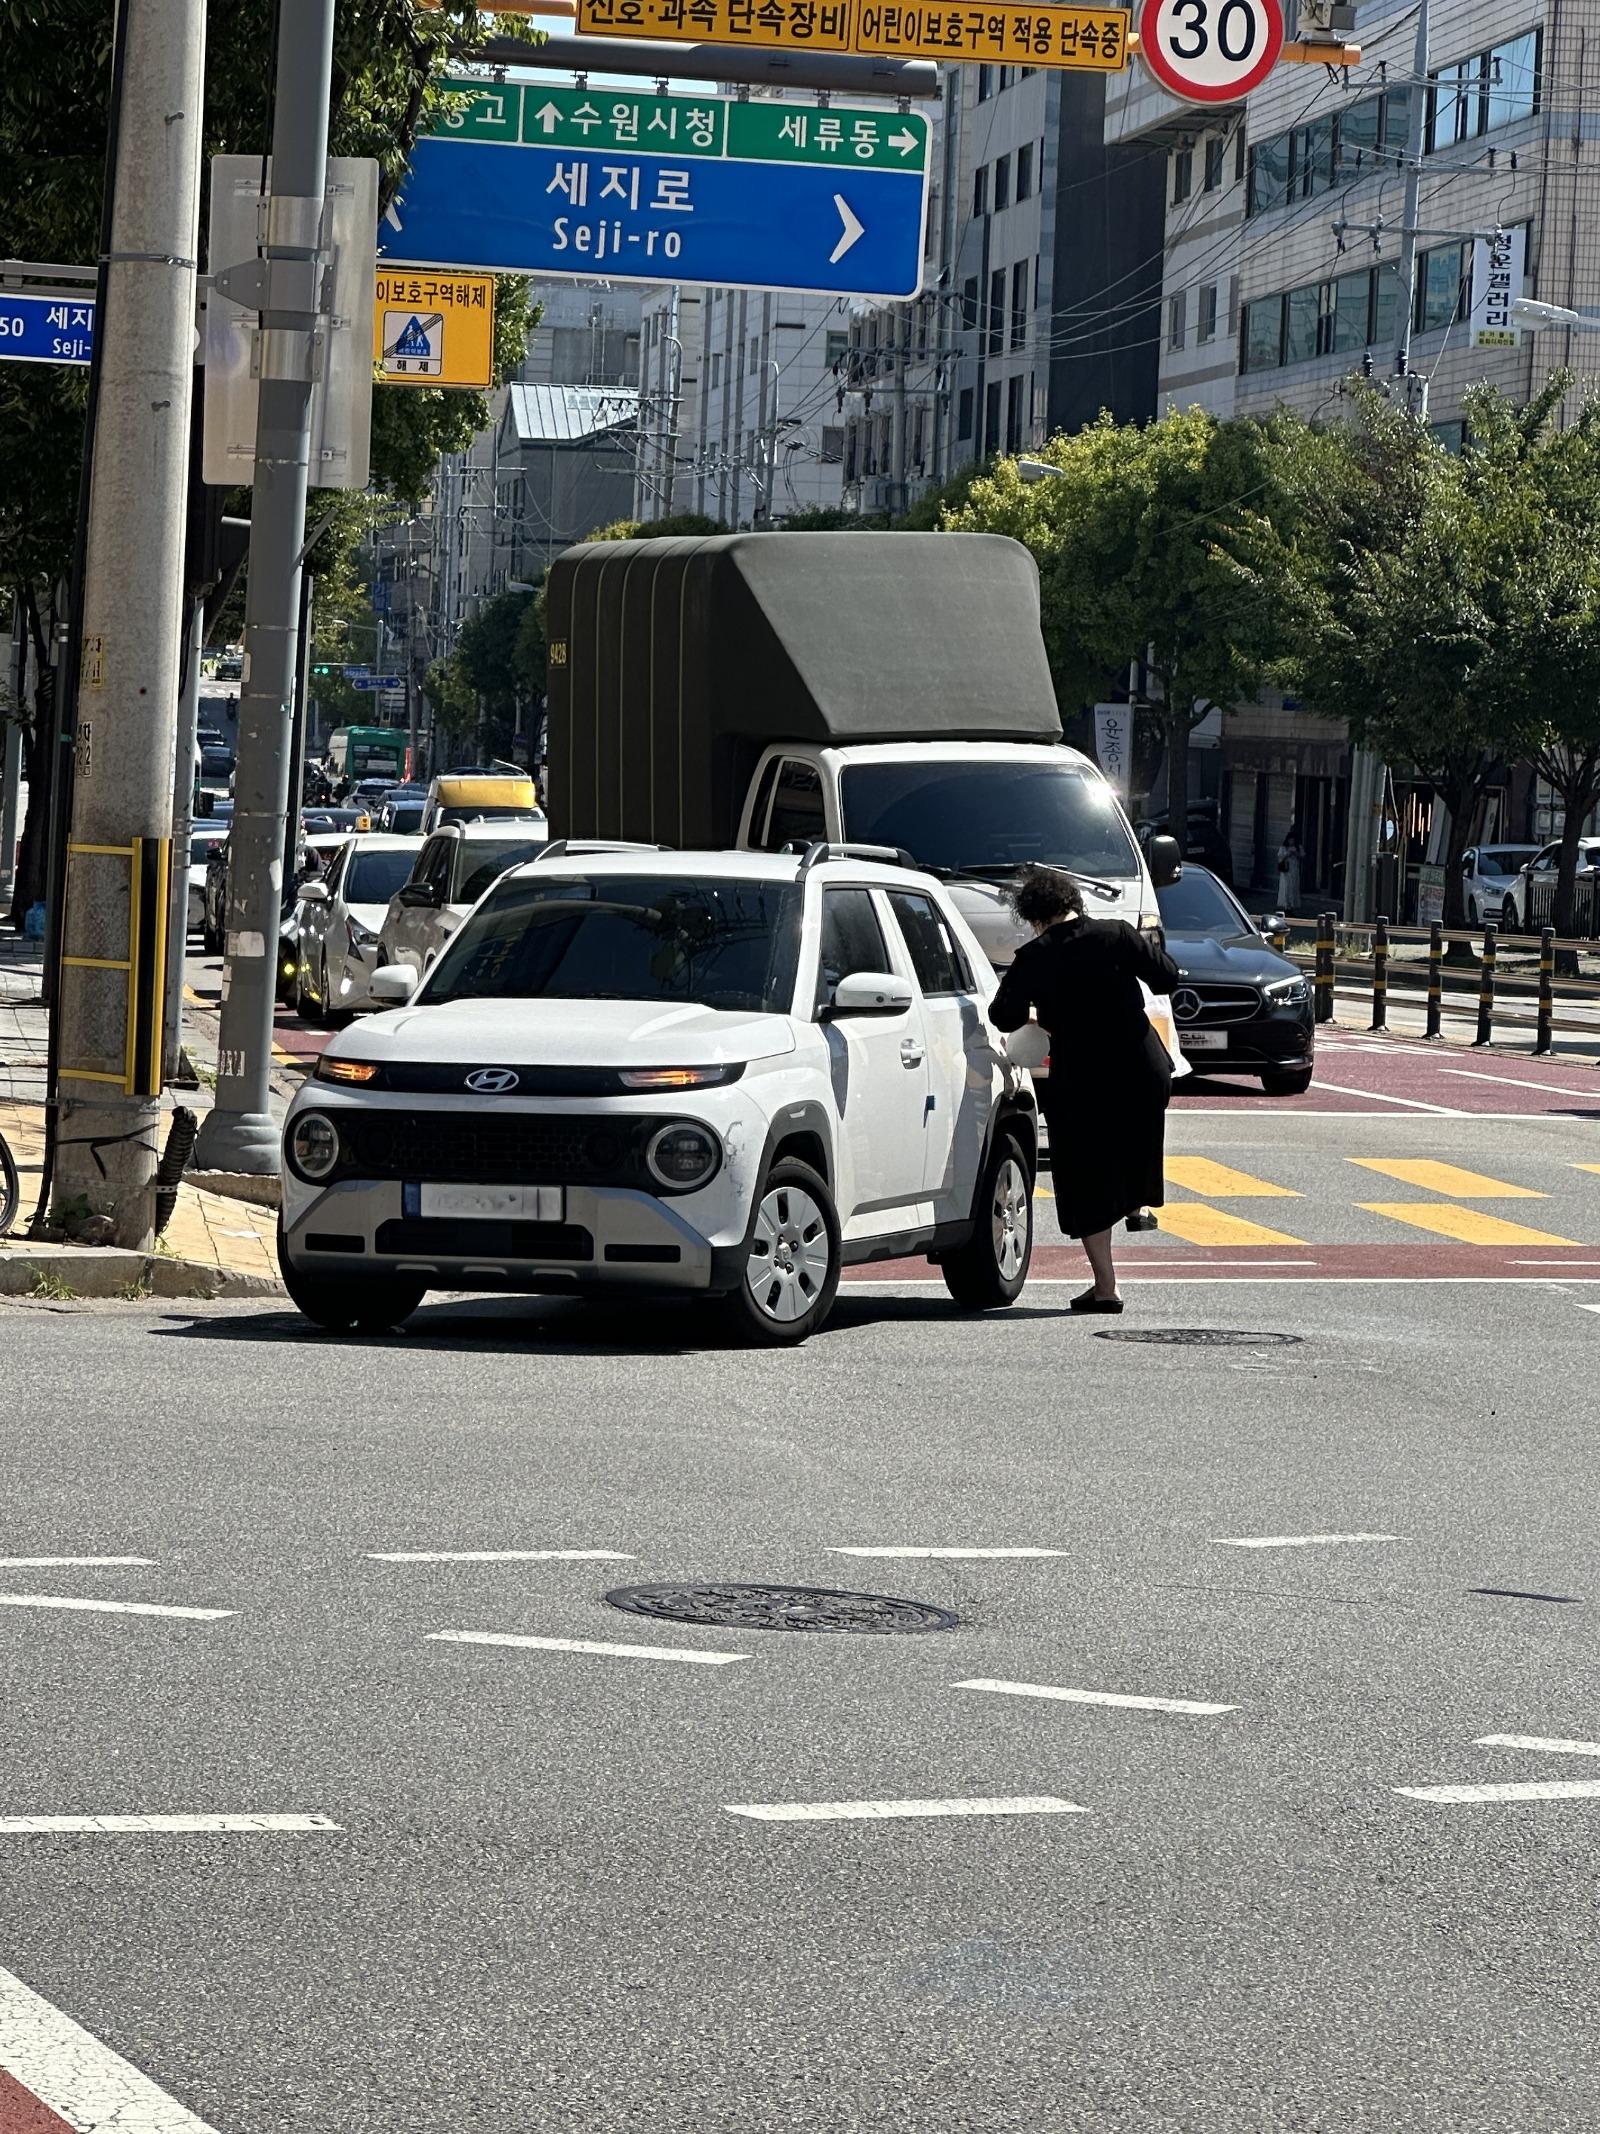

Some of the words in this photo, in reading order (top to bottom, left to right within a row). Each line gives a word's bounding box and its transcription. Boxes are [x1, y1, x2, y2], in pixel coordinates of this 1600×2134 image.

[727, 0, 847, 42] 단속장비
[862, 5, 1006, 52] 어린이보호구역
[1012, 15, 1053, 55] 적용
[1060, 19, 1120, 59] 단속중
[1169, 0, 1257, 62] 30
[569, 101, 715, 148] 수원시청
[777, 115, 881, 159] 세류동
[545, 161, 694, 212] 세지로
[552, 216, 682, 259] Seji-ro
[46, 306, 93, 332] 세지
